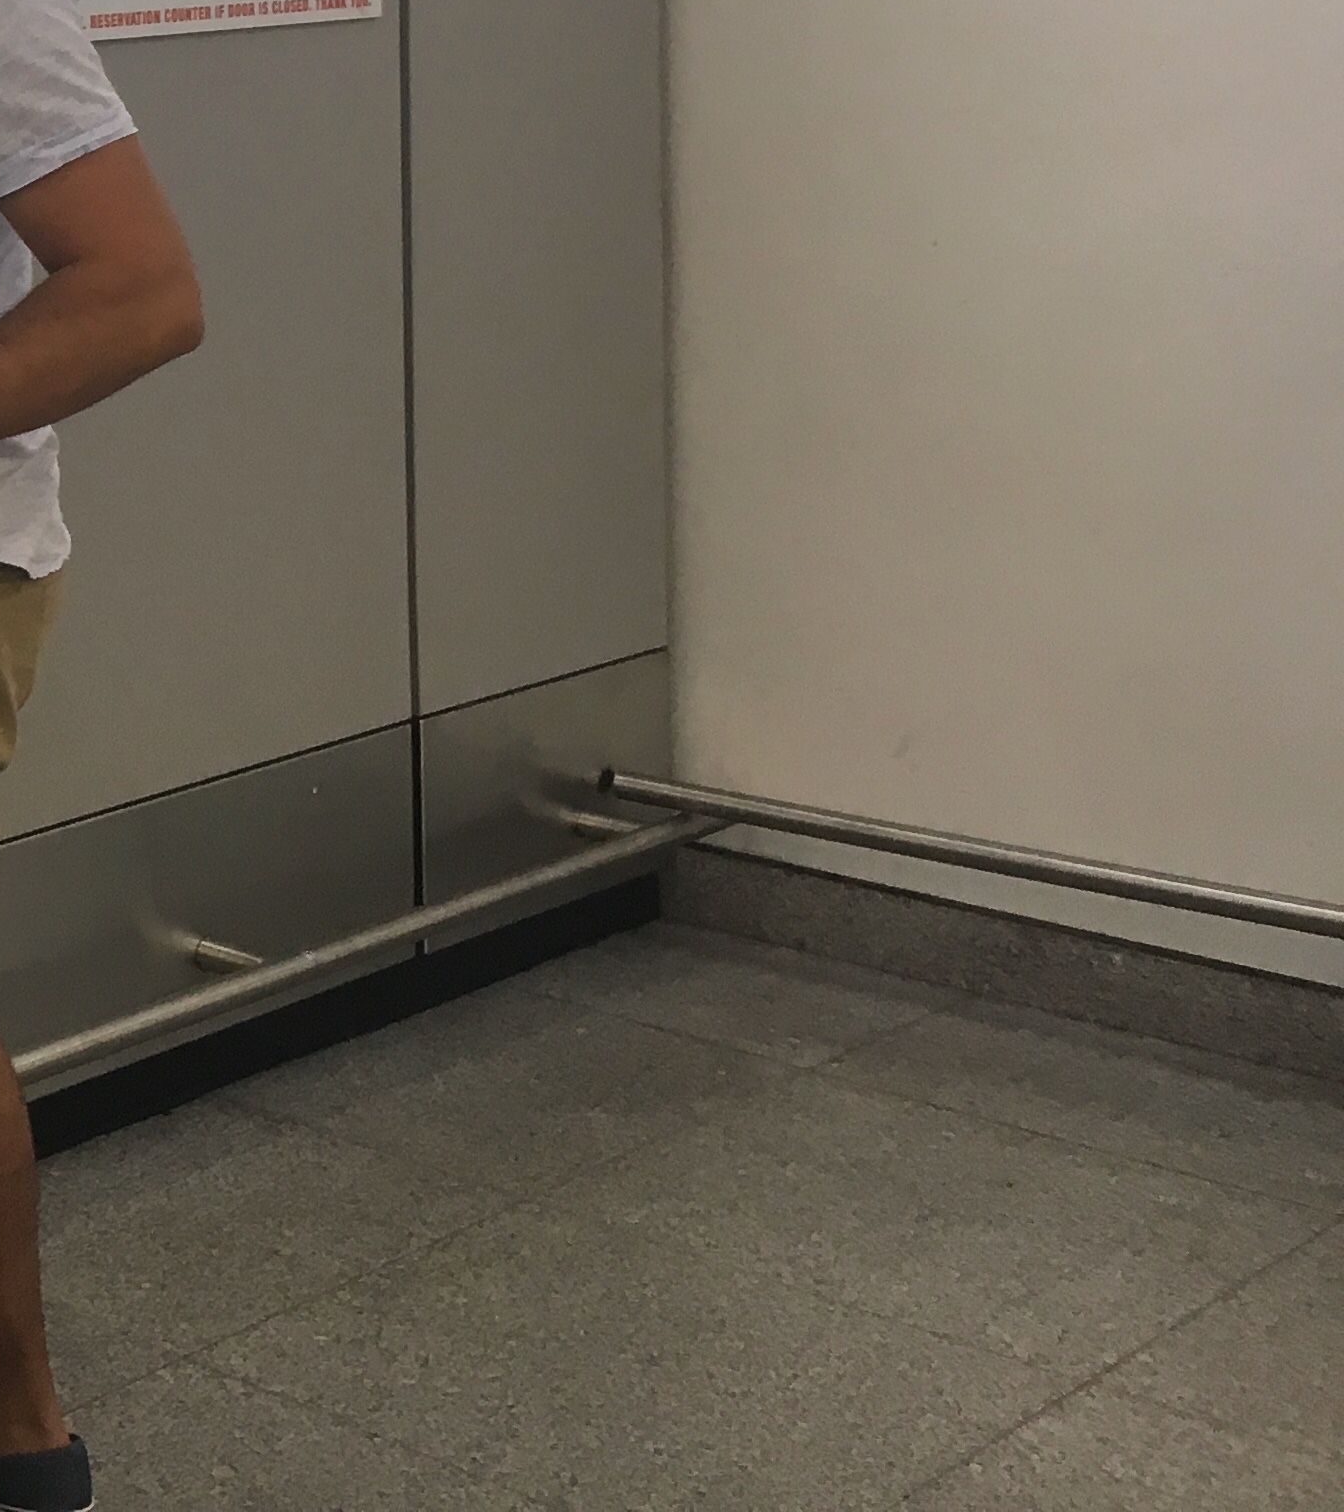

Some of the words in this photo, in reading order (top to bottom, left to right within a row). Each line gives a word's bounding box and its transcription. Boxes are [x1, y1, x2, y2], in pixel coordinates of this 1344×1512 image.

[90, 9, 161, 29] RESERVATION
[164, 5, 212, 23] COUNTER
[214, 4, 225, 19] IF
[228, 2, 256, 18] DOOR
[258, 0, 268, 15] IS
